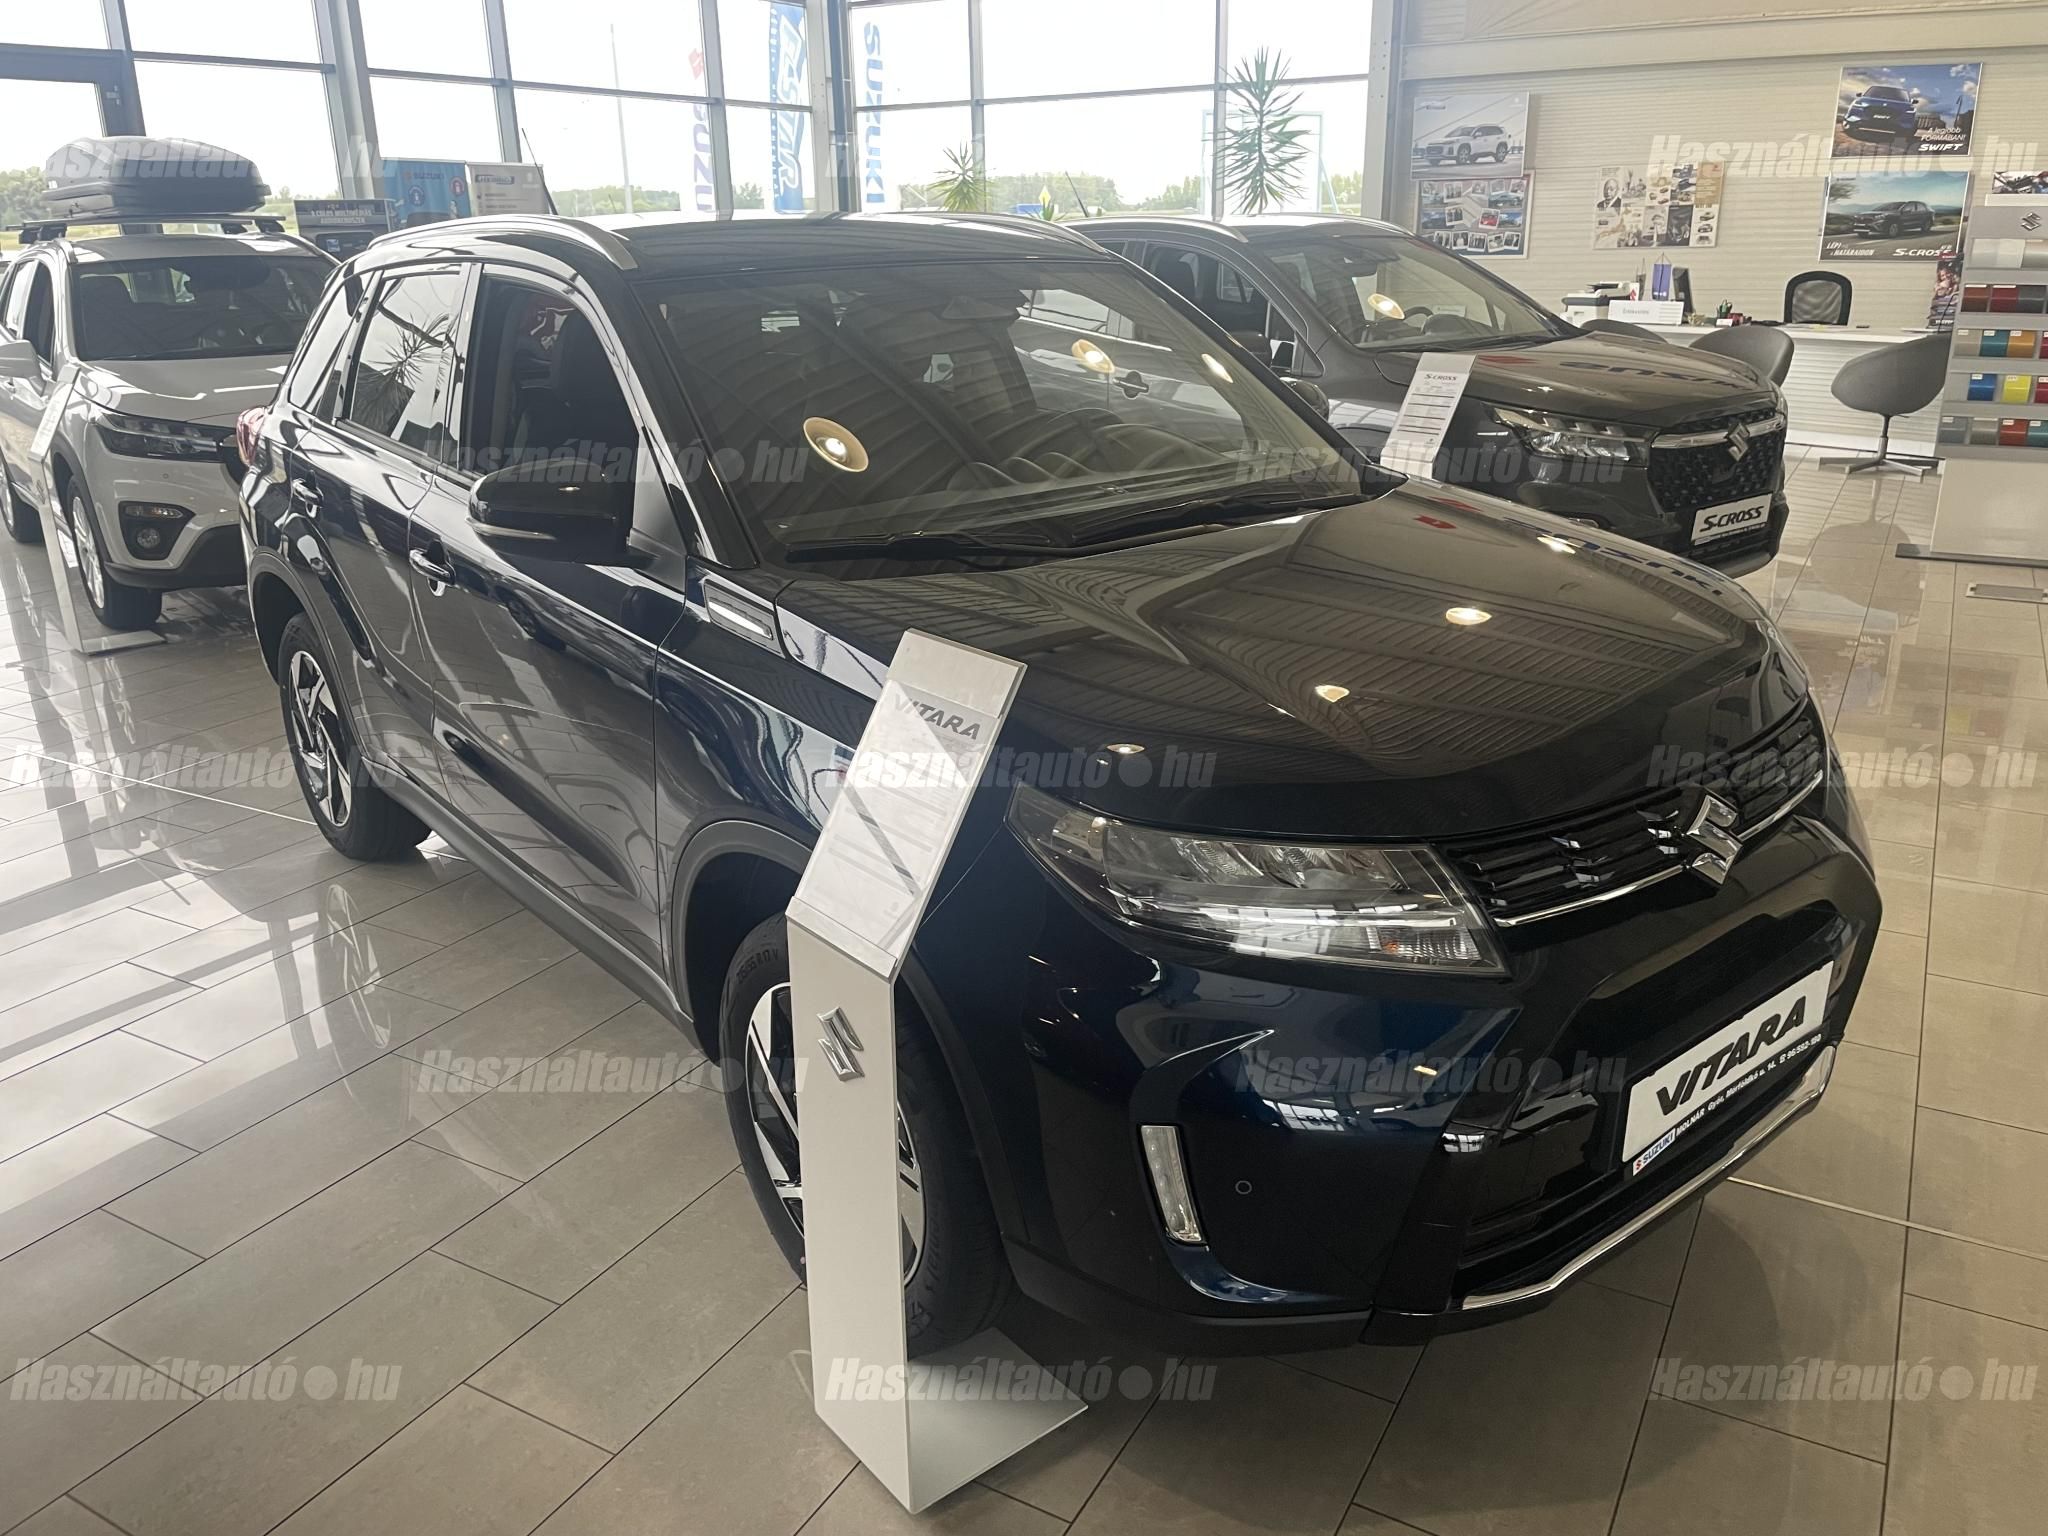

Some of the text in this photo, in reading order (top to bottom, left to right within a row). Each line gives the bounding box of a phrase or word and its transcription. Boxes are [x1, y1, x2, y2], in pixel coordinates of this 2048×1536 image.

[863, 22, 885, 204] SUZUKI
[1918, 143, 1964, 151] SWIFT
[1700, 504, 1765, 533] S-CROSS
[1655, 995, 1807, 1116] VITARA
[1641, 1131, 1675, 1165] SUZUKI
